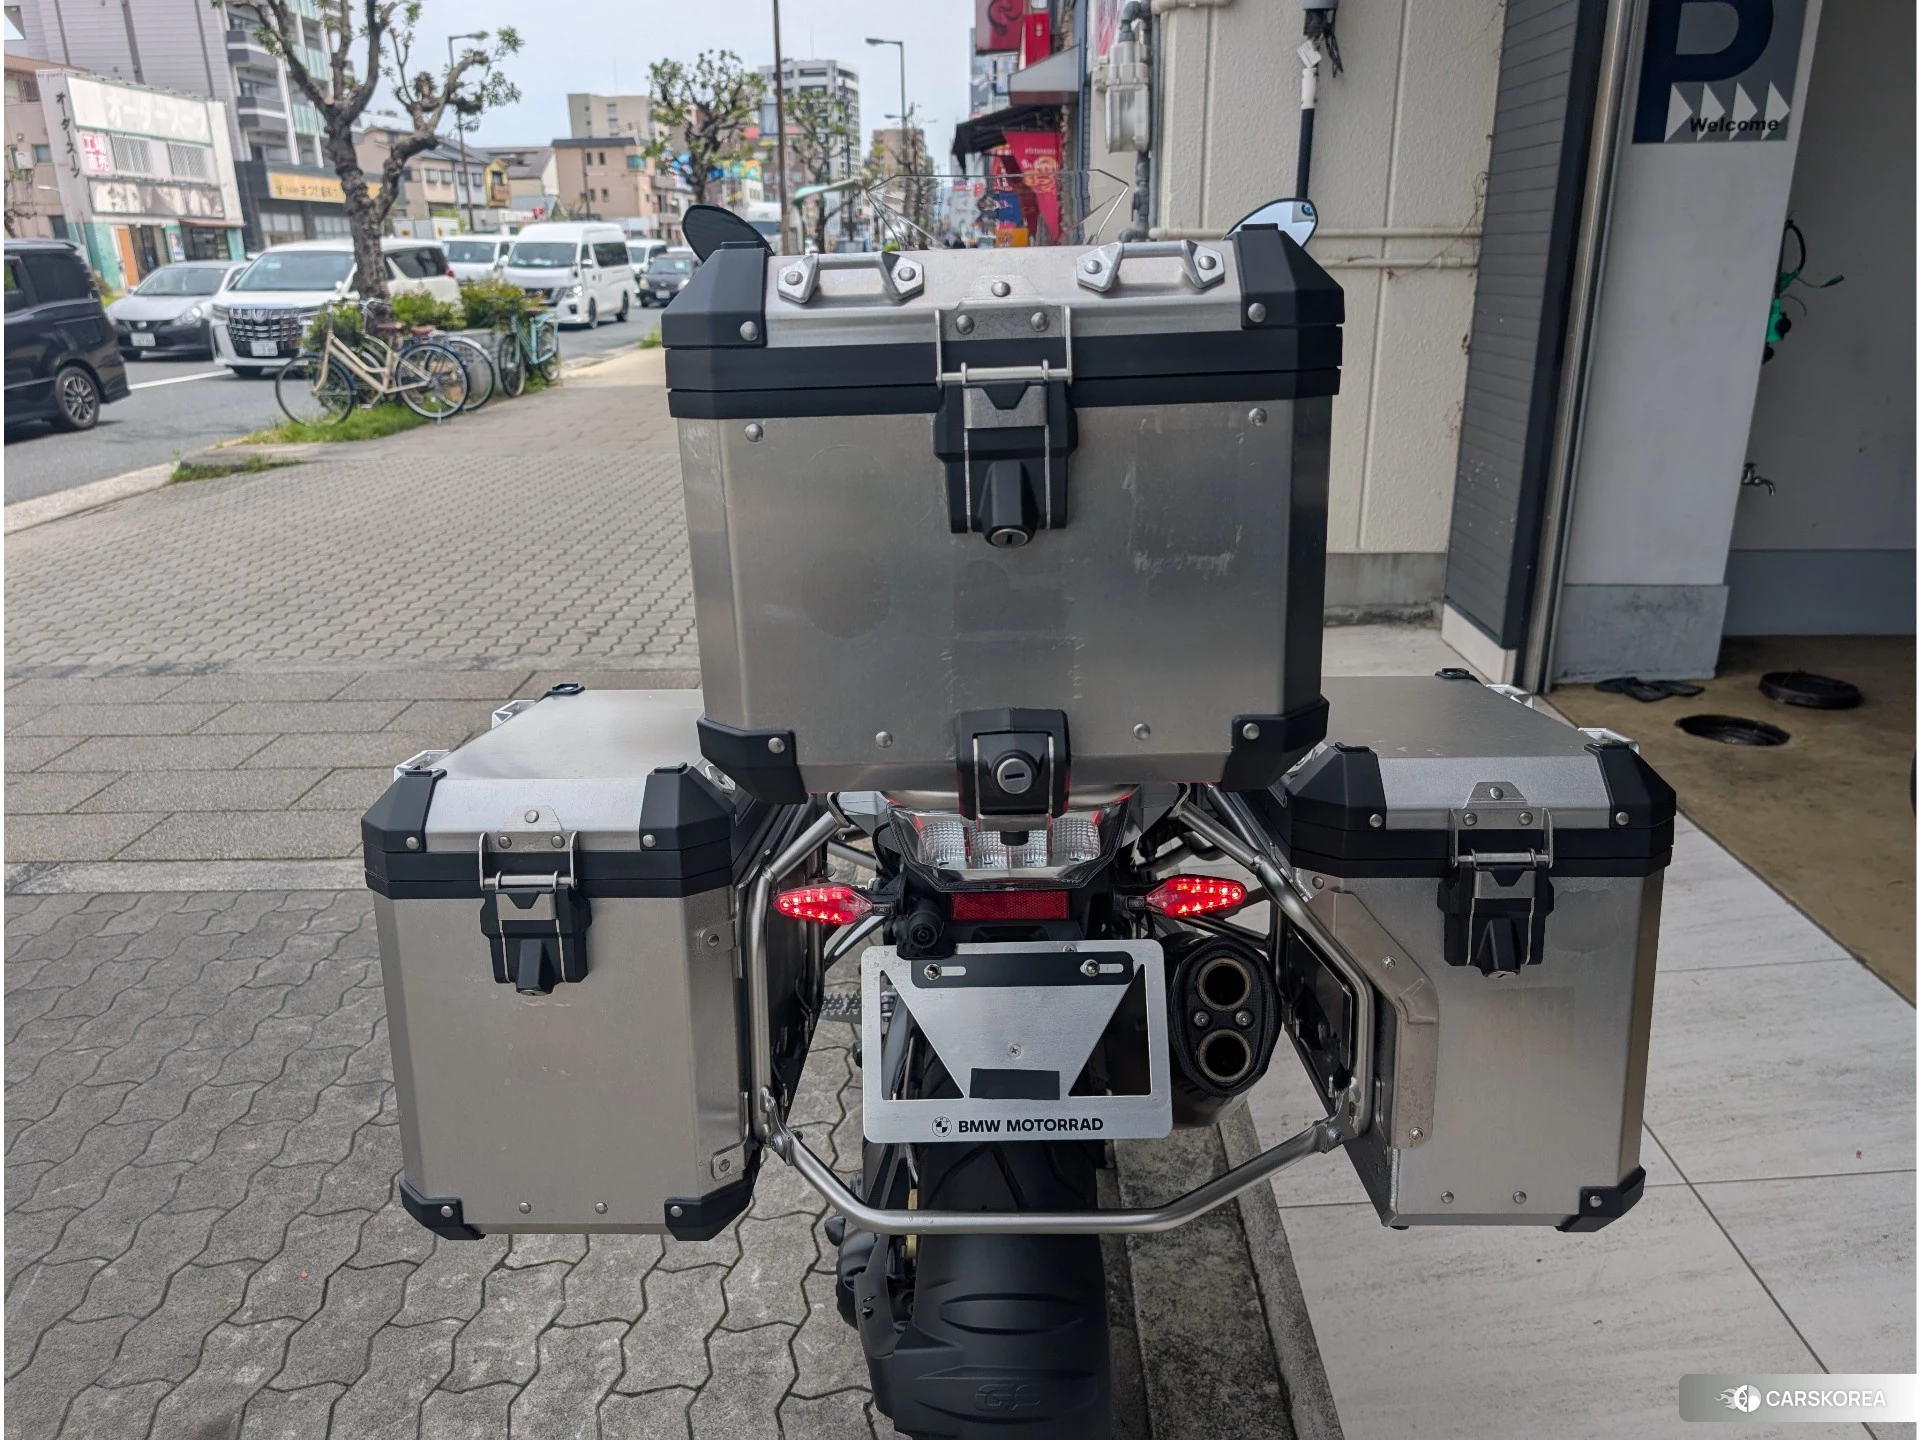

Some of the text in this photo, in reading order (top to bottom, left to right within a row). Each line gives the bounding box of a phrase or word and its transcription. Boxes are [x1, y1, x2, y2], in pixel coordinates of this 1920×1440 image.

[1689, 117, 1780, 133] Welcome
[56, 92, 80, 178] オーダースーツ
[958, 1117, 1104, 1134] BMW MOTORRAD
